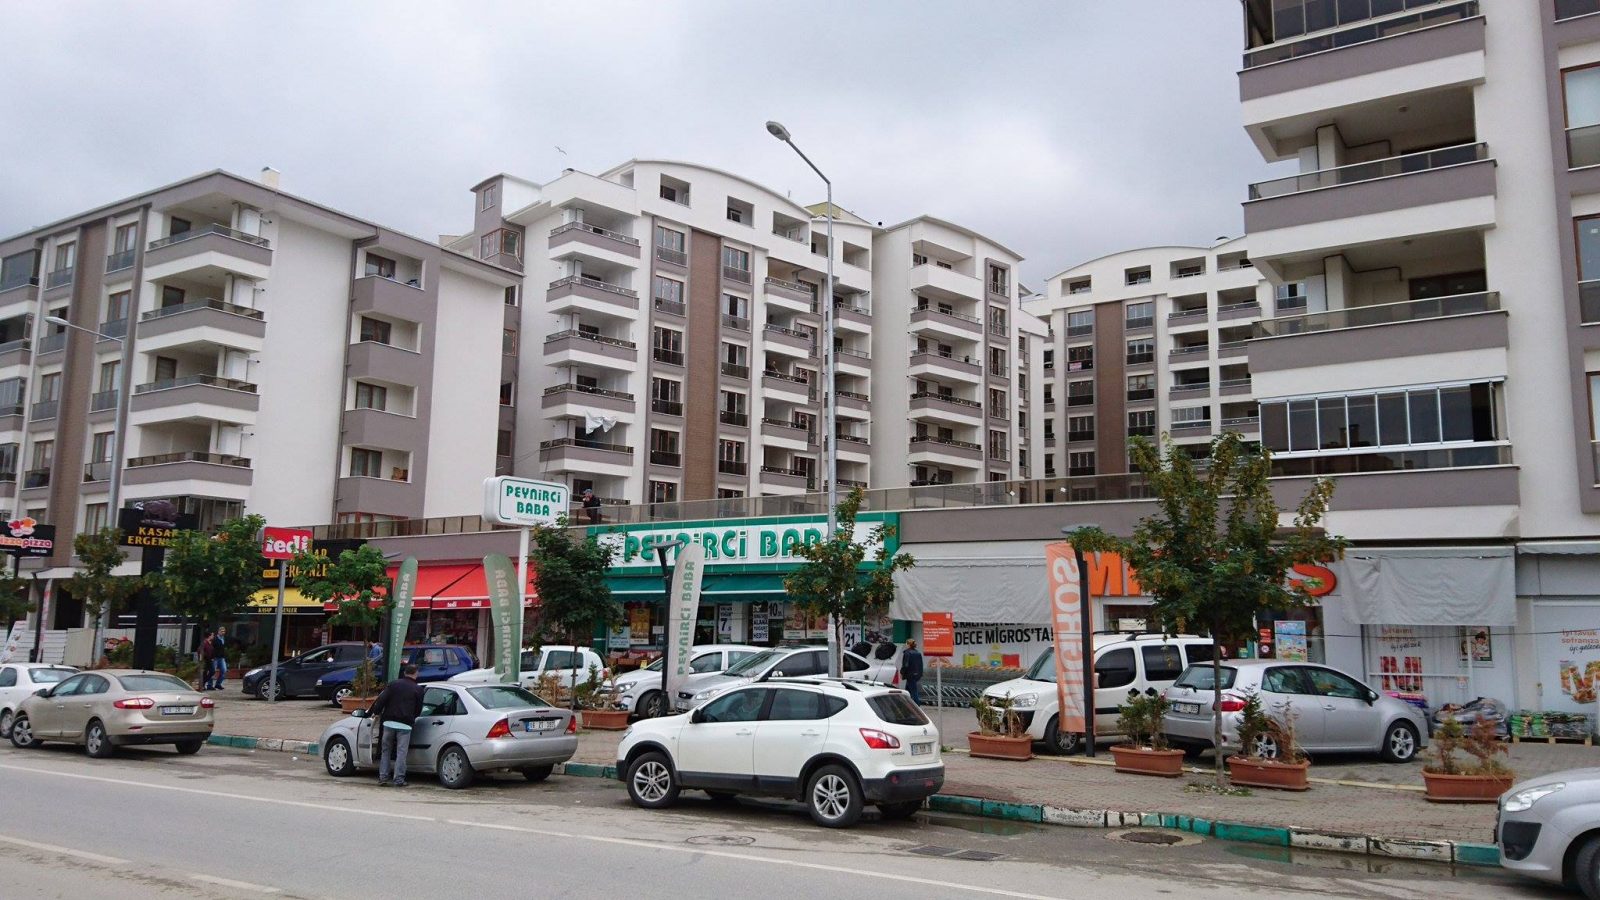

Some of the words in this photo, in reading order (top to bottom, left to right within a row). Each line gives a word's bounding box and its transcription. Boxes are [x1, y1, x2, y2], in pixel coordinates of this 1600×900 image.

[516, 501, 550, 516] BABA
[759, 528, 842, 558] BAB
[682, 561, 695, 602] BABA
[845, 632, 855, 647] 21
[953, 629, 983, 646] DECE
